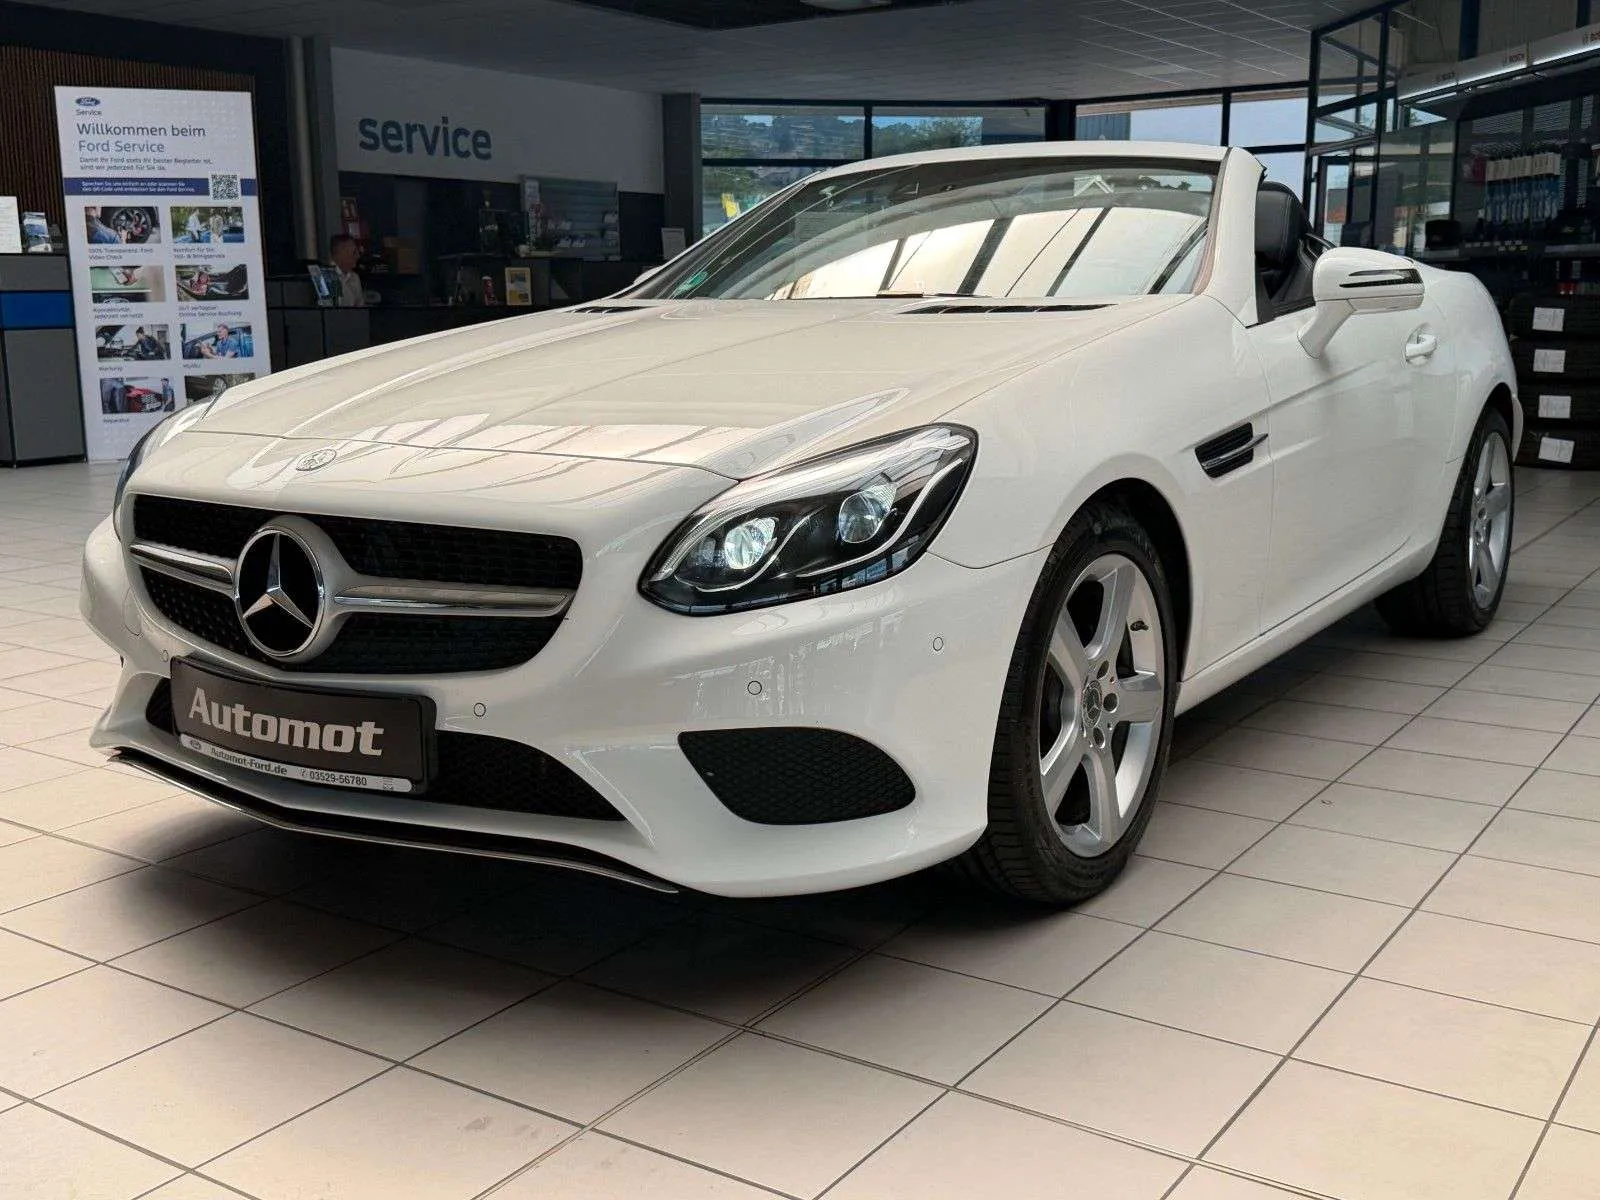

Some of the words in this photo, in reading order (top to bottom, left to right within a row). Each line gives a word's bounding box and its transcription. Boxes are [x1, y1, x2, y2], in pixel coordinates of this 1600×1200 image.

[76, 123, 168, 136] Willkommen
[171, 125, 206, 137] beim
[78, 141, 110, 152] Ford
[114, 141, 165, 152] Service
[359, 115, 493, 160] service
[189, 687, 384, 756] Automot
[211, 747, 288, 776] Automot-Ford.de
[309, 770, 368, 786] 03529-56780
